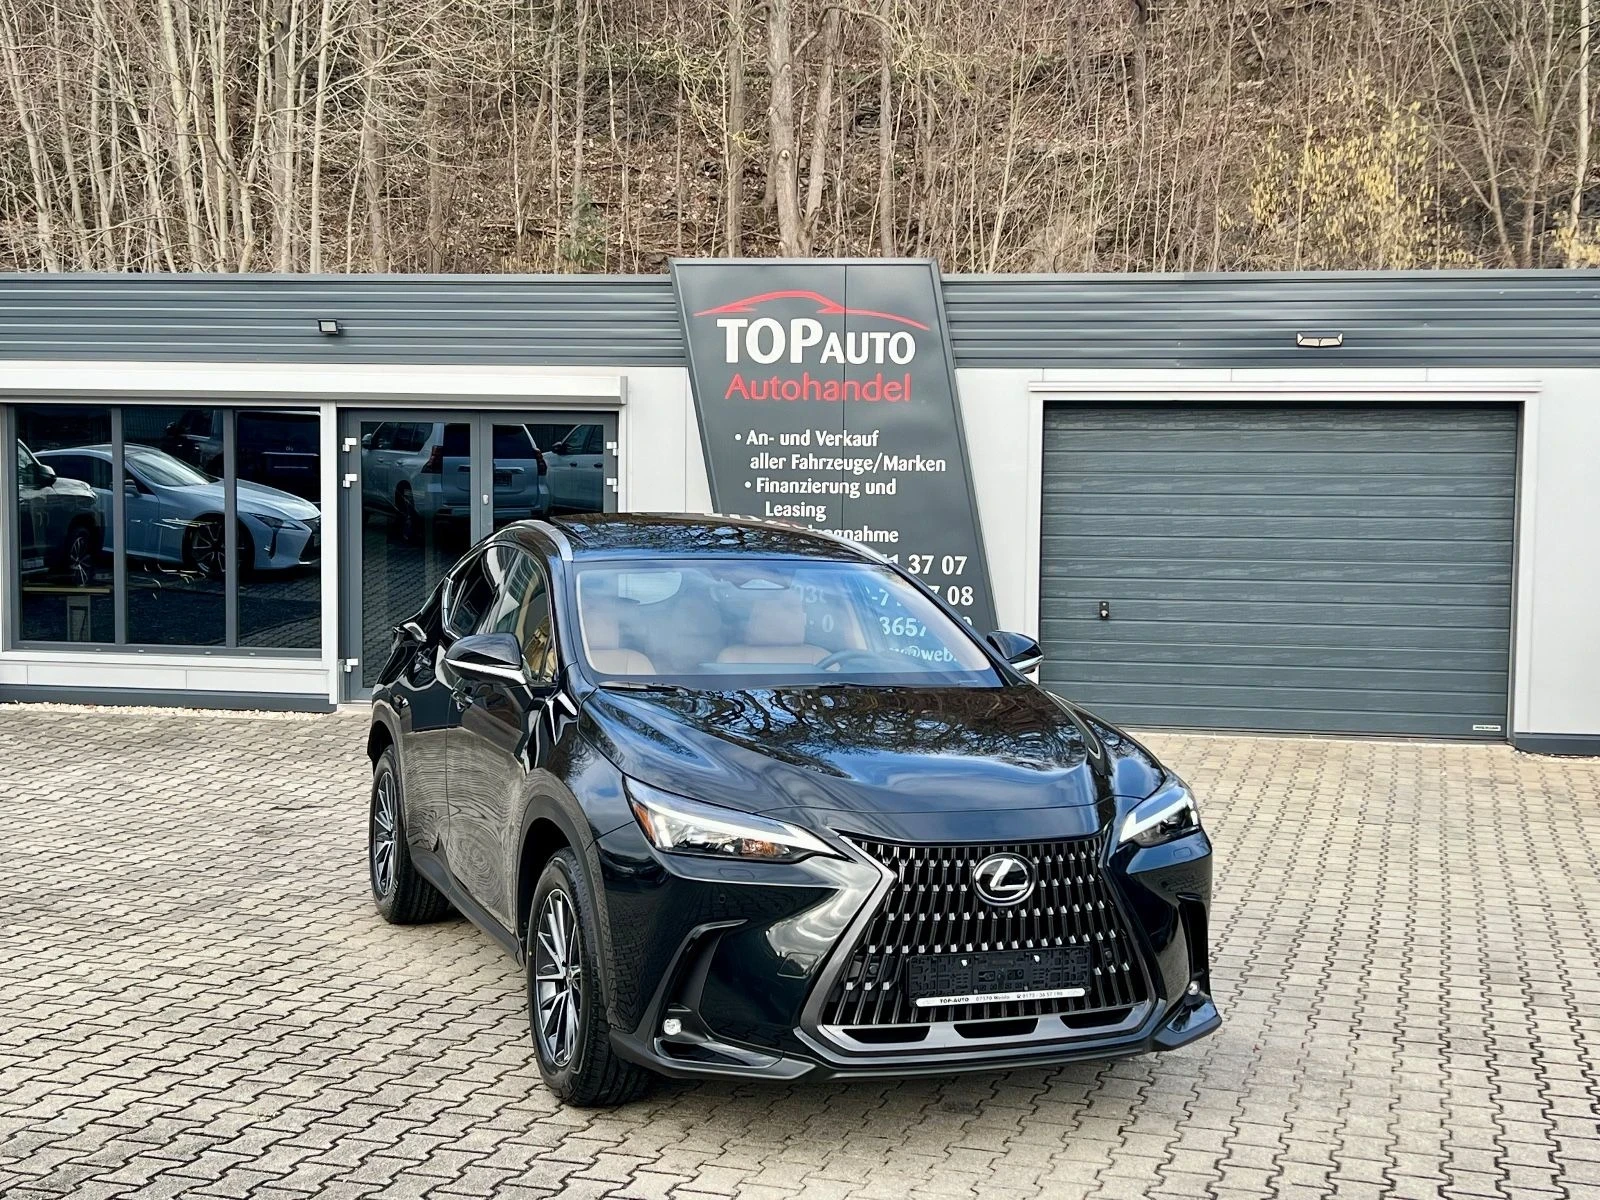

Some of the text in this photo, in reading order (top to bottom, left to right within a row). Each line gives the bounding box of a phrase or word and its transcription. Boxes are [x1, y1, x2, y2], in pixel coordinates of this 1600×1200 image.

[725, 372, 911, 402] Autohandel
[746, 429, 879, 447] An- und Verkauf
[750, 453, 946, 475] aller Fahrzeuge/Marken
[756, 478, 896, 498] Finanzierung und
[765, 501, 827, 522] Leasing
[908, 554, 935, 574] 37
[941, 555, 968, 575] 07
[947, 585, 974, 606] 08
